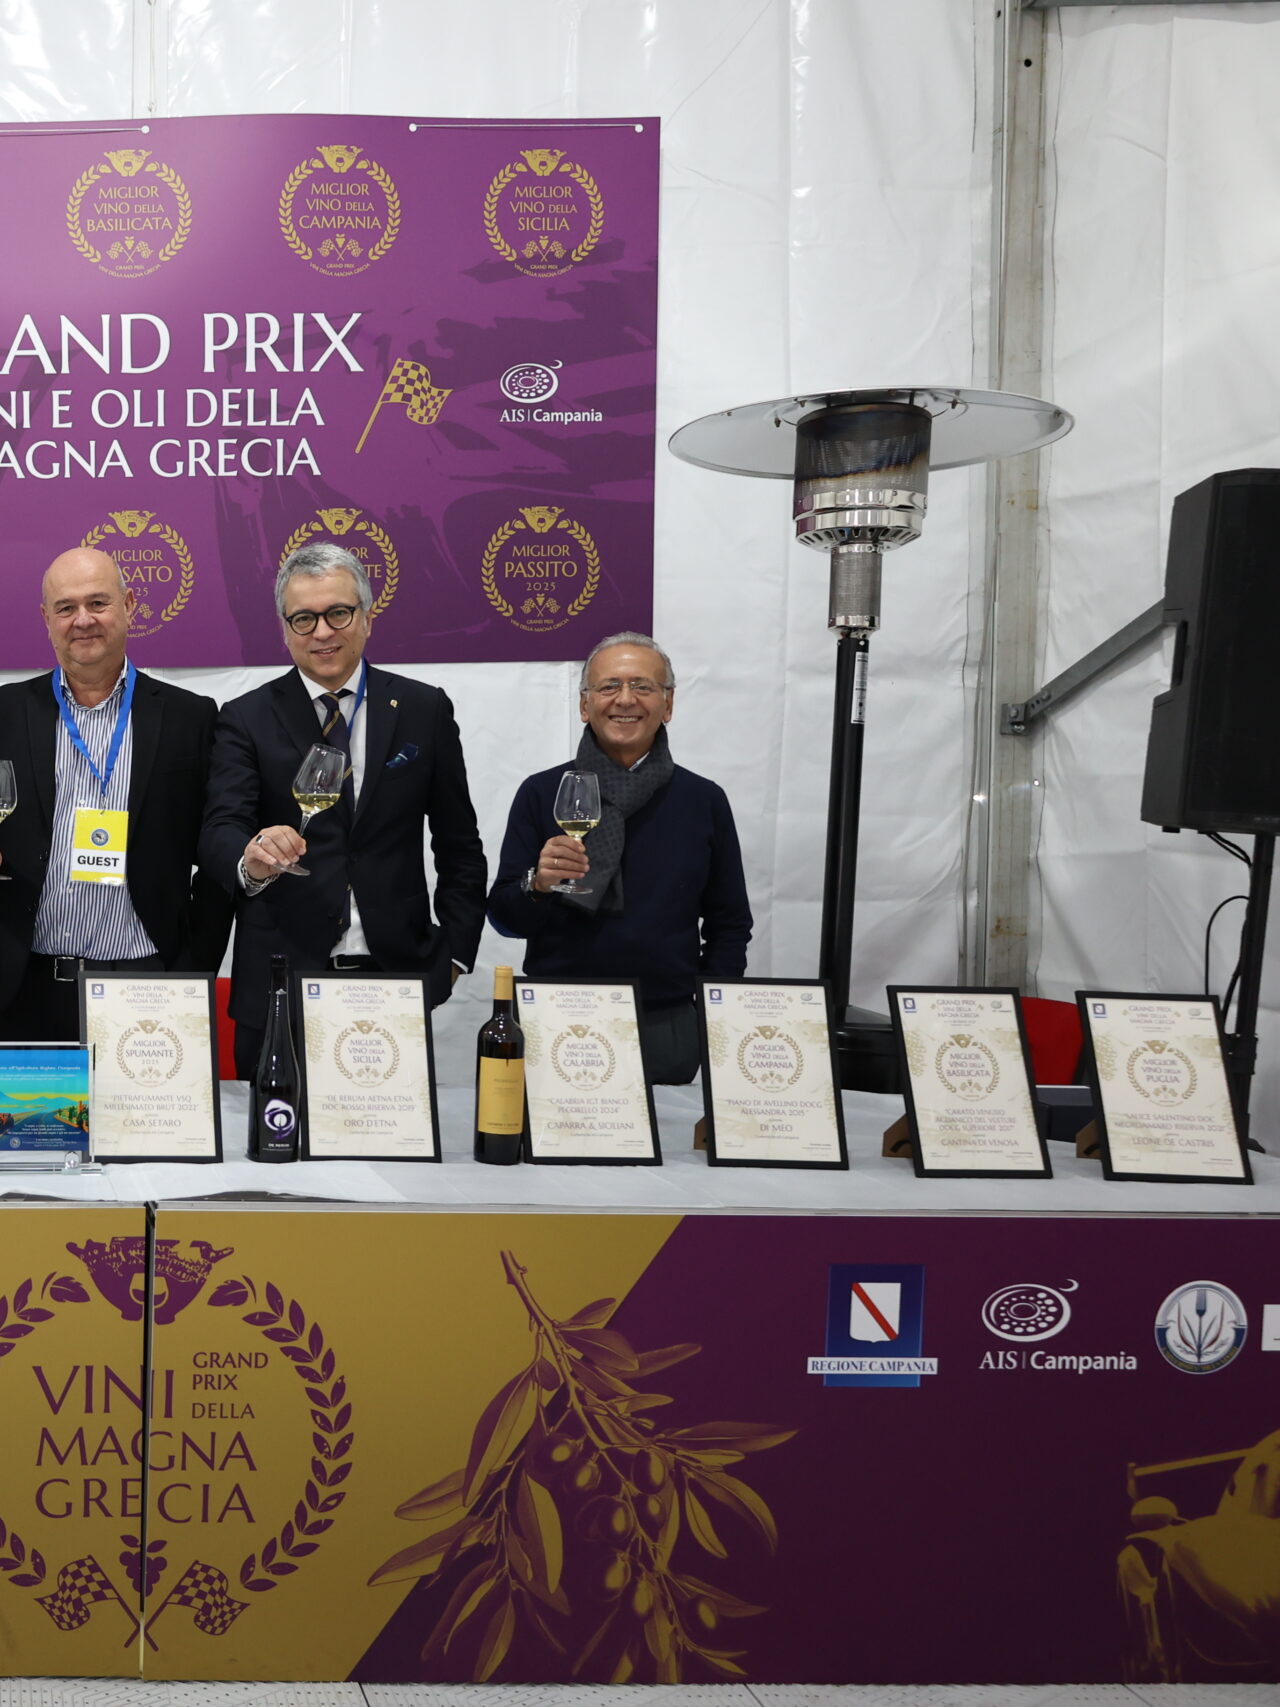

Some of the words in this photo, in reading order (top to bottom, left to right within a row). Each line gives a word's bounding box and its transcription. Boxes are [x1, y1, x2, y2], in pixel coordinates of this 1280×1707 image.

[99, 186, 159, 199] MIGLIOR
[311, 183, 369, 196] MIGLIOR
[515, 186, 573, 198] MIGLIOR
[93, 202, 130, 215] VINO
[134, 203, 164, 213] DELLA
[306, 199, 341, 211] VINO
[345, 202, 374, 211] DELLA
[510, 201, 544, 213] VINO
[549, 204, 577, 213] DELLA
[87, 217, 173, 232] BASILICATA
[299, 215, 381, 229] CAMPANIA
[518, 217, 570, 231] SICILIA
[203, 312, 364, 374] PRIX
[52, 389, 72, 428] E
[91, 388, 165, 428] OLI
[186, 388, 325, 428] DELLA
[500, 408, 525, 424] AIS
[533, 408, 603, 424] Campania
[149, 438, 322, 478] GRECIA
[512, 545, 570, 557] MIGLIOR
[122, 566, 173, 583] SATO
[505, 561, 578, 578] PASSITO
[526, 582, 556, 591] 2025
[78, 855, 120, 867] GUEST
[126, 1049, 174, 1058] SPUMANTE
[753, 1044, 786, 1052] MIGLIOR
[353, 1056, 382, 1064] SICILIA
[563, 1059, 605, 1067] CALABRIA
[748, 1061, 794, 1069] CAMPANIA
[947, 1069, 991, 1077] BASILICATA
[1147, 1075, 1180, 1083] PUGLIA
[192, 1352, 269, 1369] GRAND
[811, 1359, 868, 1373] REGIONE
[869, 1359, 935, 1373] CAMPANIA
[979, 1351, 1018, 1370] AIS
[1030, 1351, 1137, 1375] Campania
[192, 1374, 238, 1391] PRIX
[32, 1365, 174, 1419] VINI
[192, 1403, 255, 1419] DELLA
[35, 1426, 258, 1472] MAGNA
[35, 1478, 256, 1524] GRECIA
